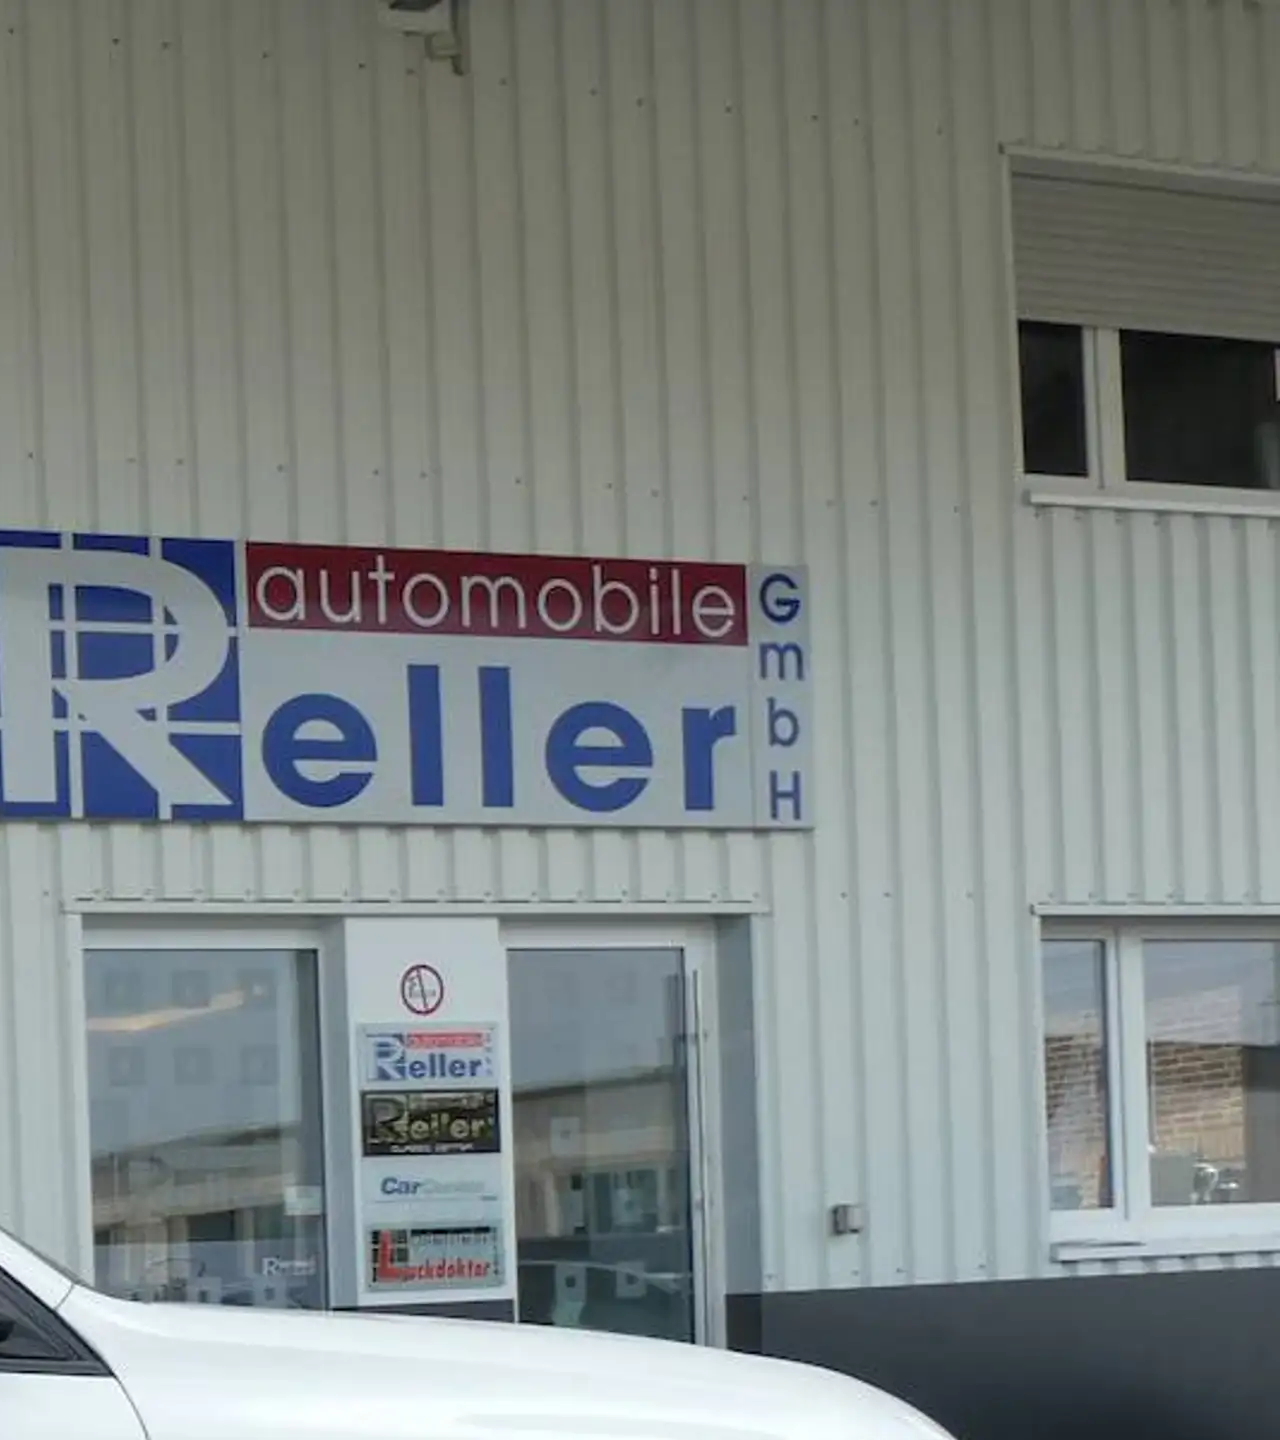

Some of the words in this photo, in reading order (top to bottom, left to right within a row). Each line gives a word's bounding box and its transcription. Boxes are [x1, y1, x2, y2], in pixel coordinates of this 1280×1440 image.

[256, 554, 737, 638] automobile
[758, 571, 806, 823] GmbH
[367, 1034, 482, 1080] Reller
